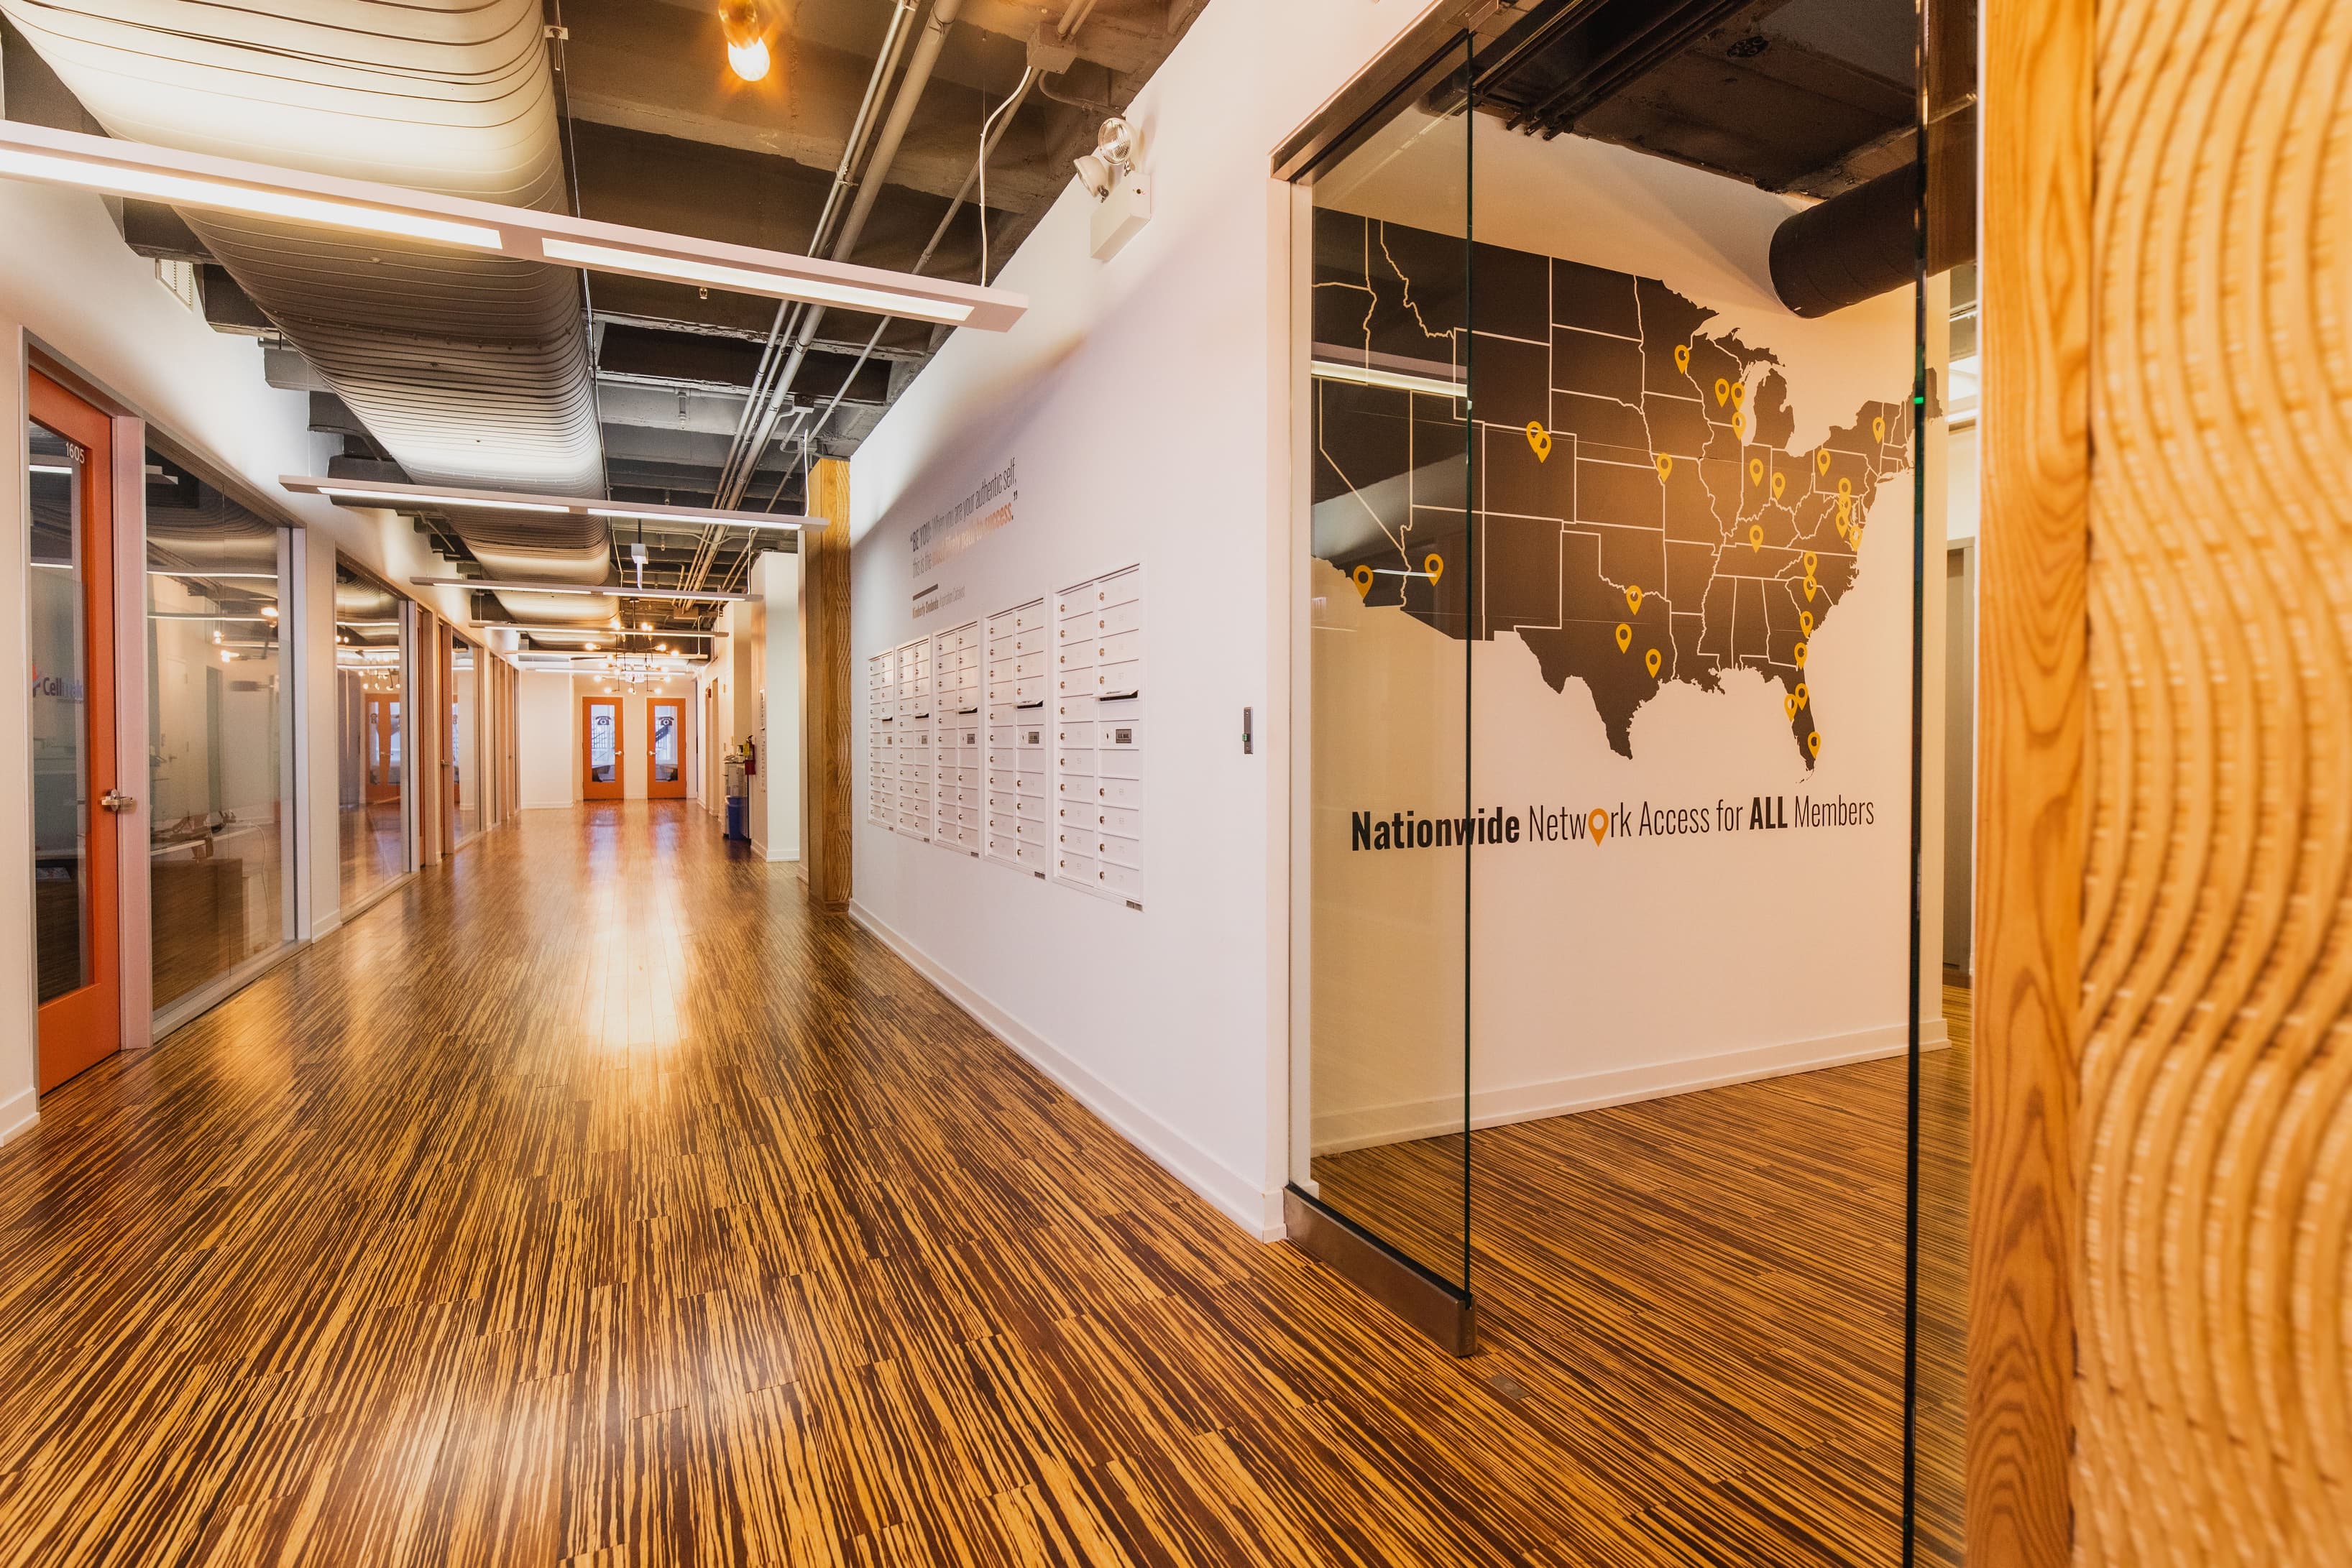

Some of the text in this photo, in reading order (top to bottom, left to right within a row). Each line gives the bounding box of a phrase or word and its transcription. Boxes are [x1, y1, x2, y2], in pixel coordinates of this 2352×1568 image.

[65, 441, 85, 464] 1605
[954, 502, 963, 524] are
[963, 492, 975, 522] your
[975, 471, 1002, 509] authentic
[1351, 806, 1520, 851] Nationwide
[1639, 801, 1710, 836] Access
[1716, 798, 1743, 831] for
[1749, 795, 1788, 830] ALL
[1794, 794, 1875, 828] Members
